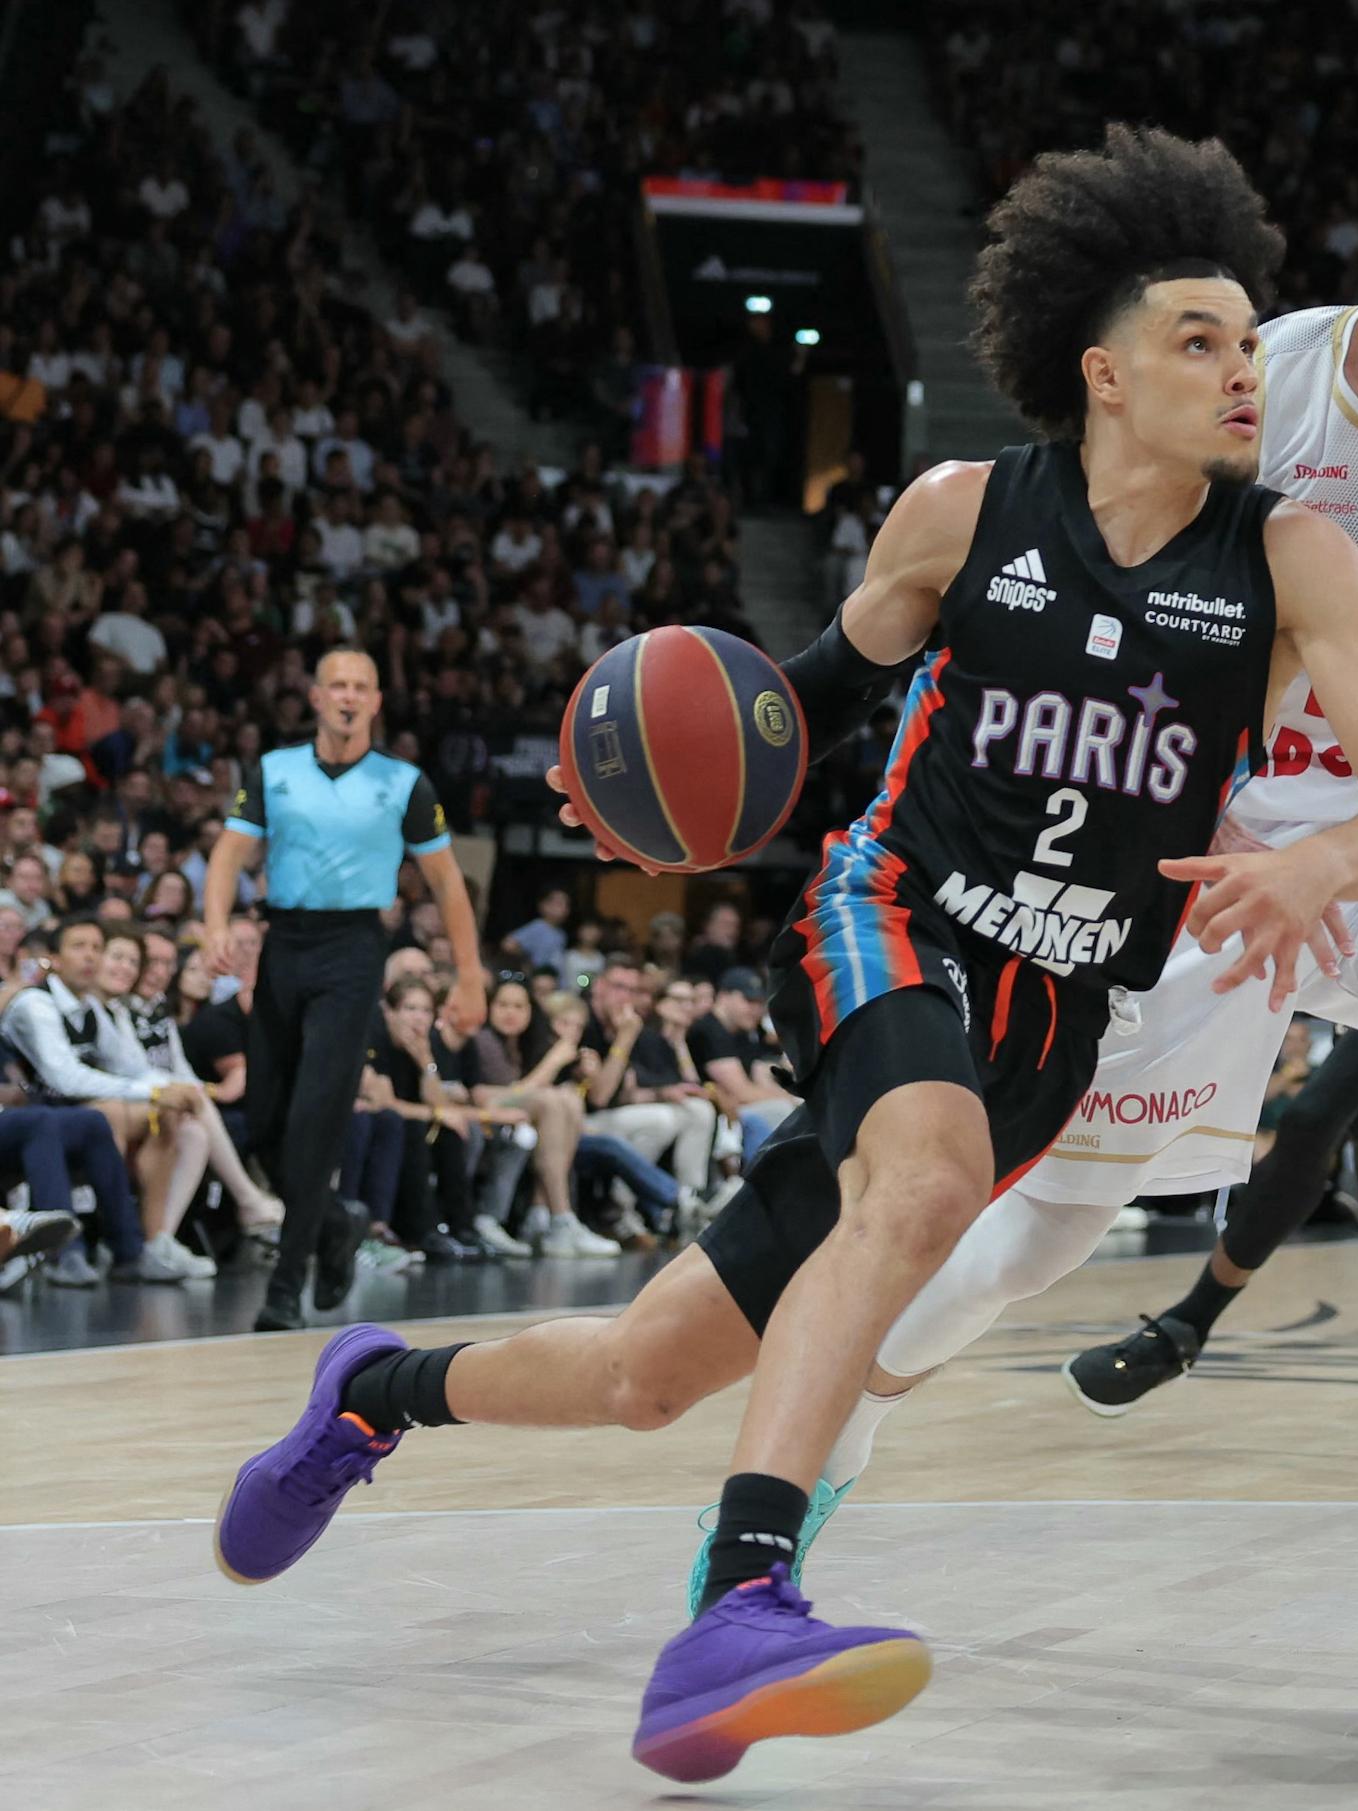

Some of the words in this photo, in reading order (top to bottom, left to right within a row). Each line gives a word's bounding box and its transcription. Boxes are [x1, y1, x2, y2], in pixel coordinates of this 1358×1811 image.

[1144, 610, 1243, 641] COURTYARD
[1147, 591, 1246, 619] nutribullet.
[972, 687, 1198, 803] PARIS
[1032, 787, 1089, 868] 2
[934, 871, 1133, 966] MENNEN
